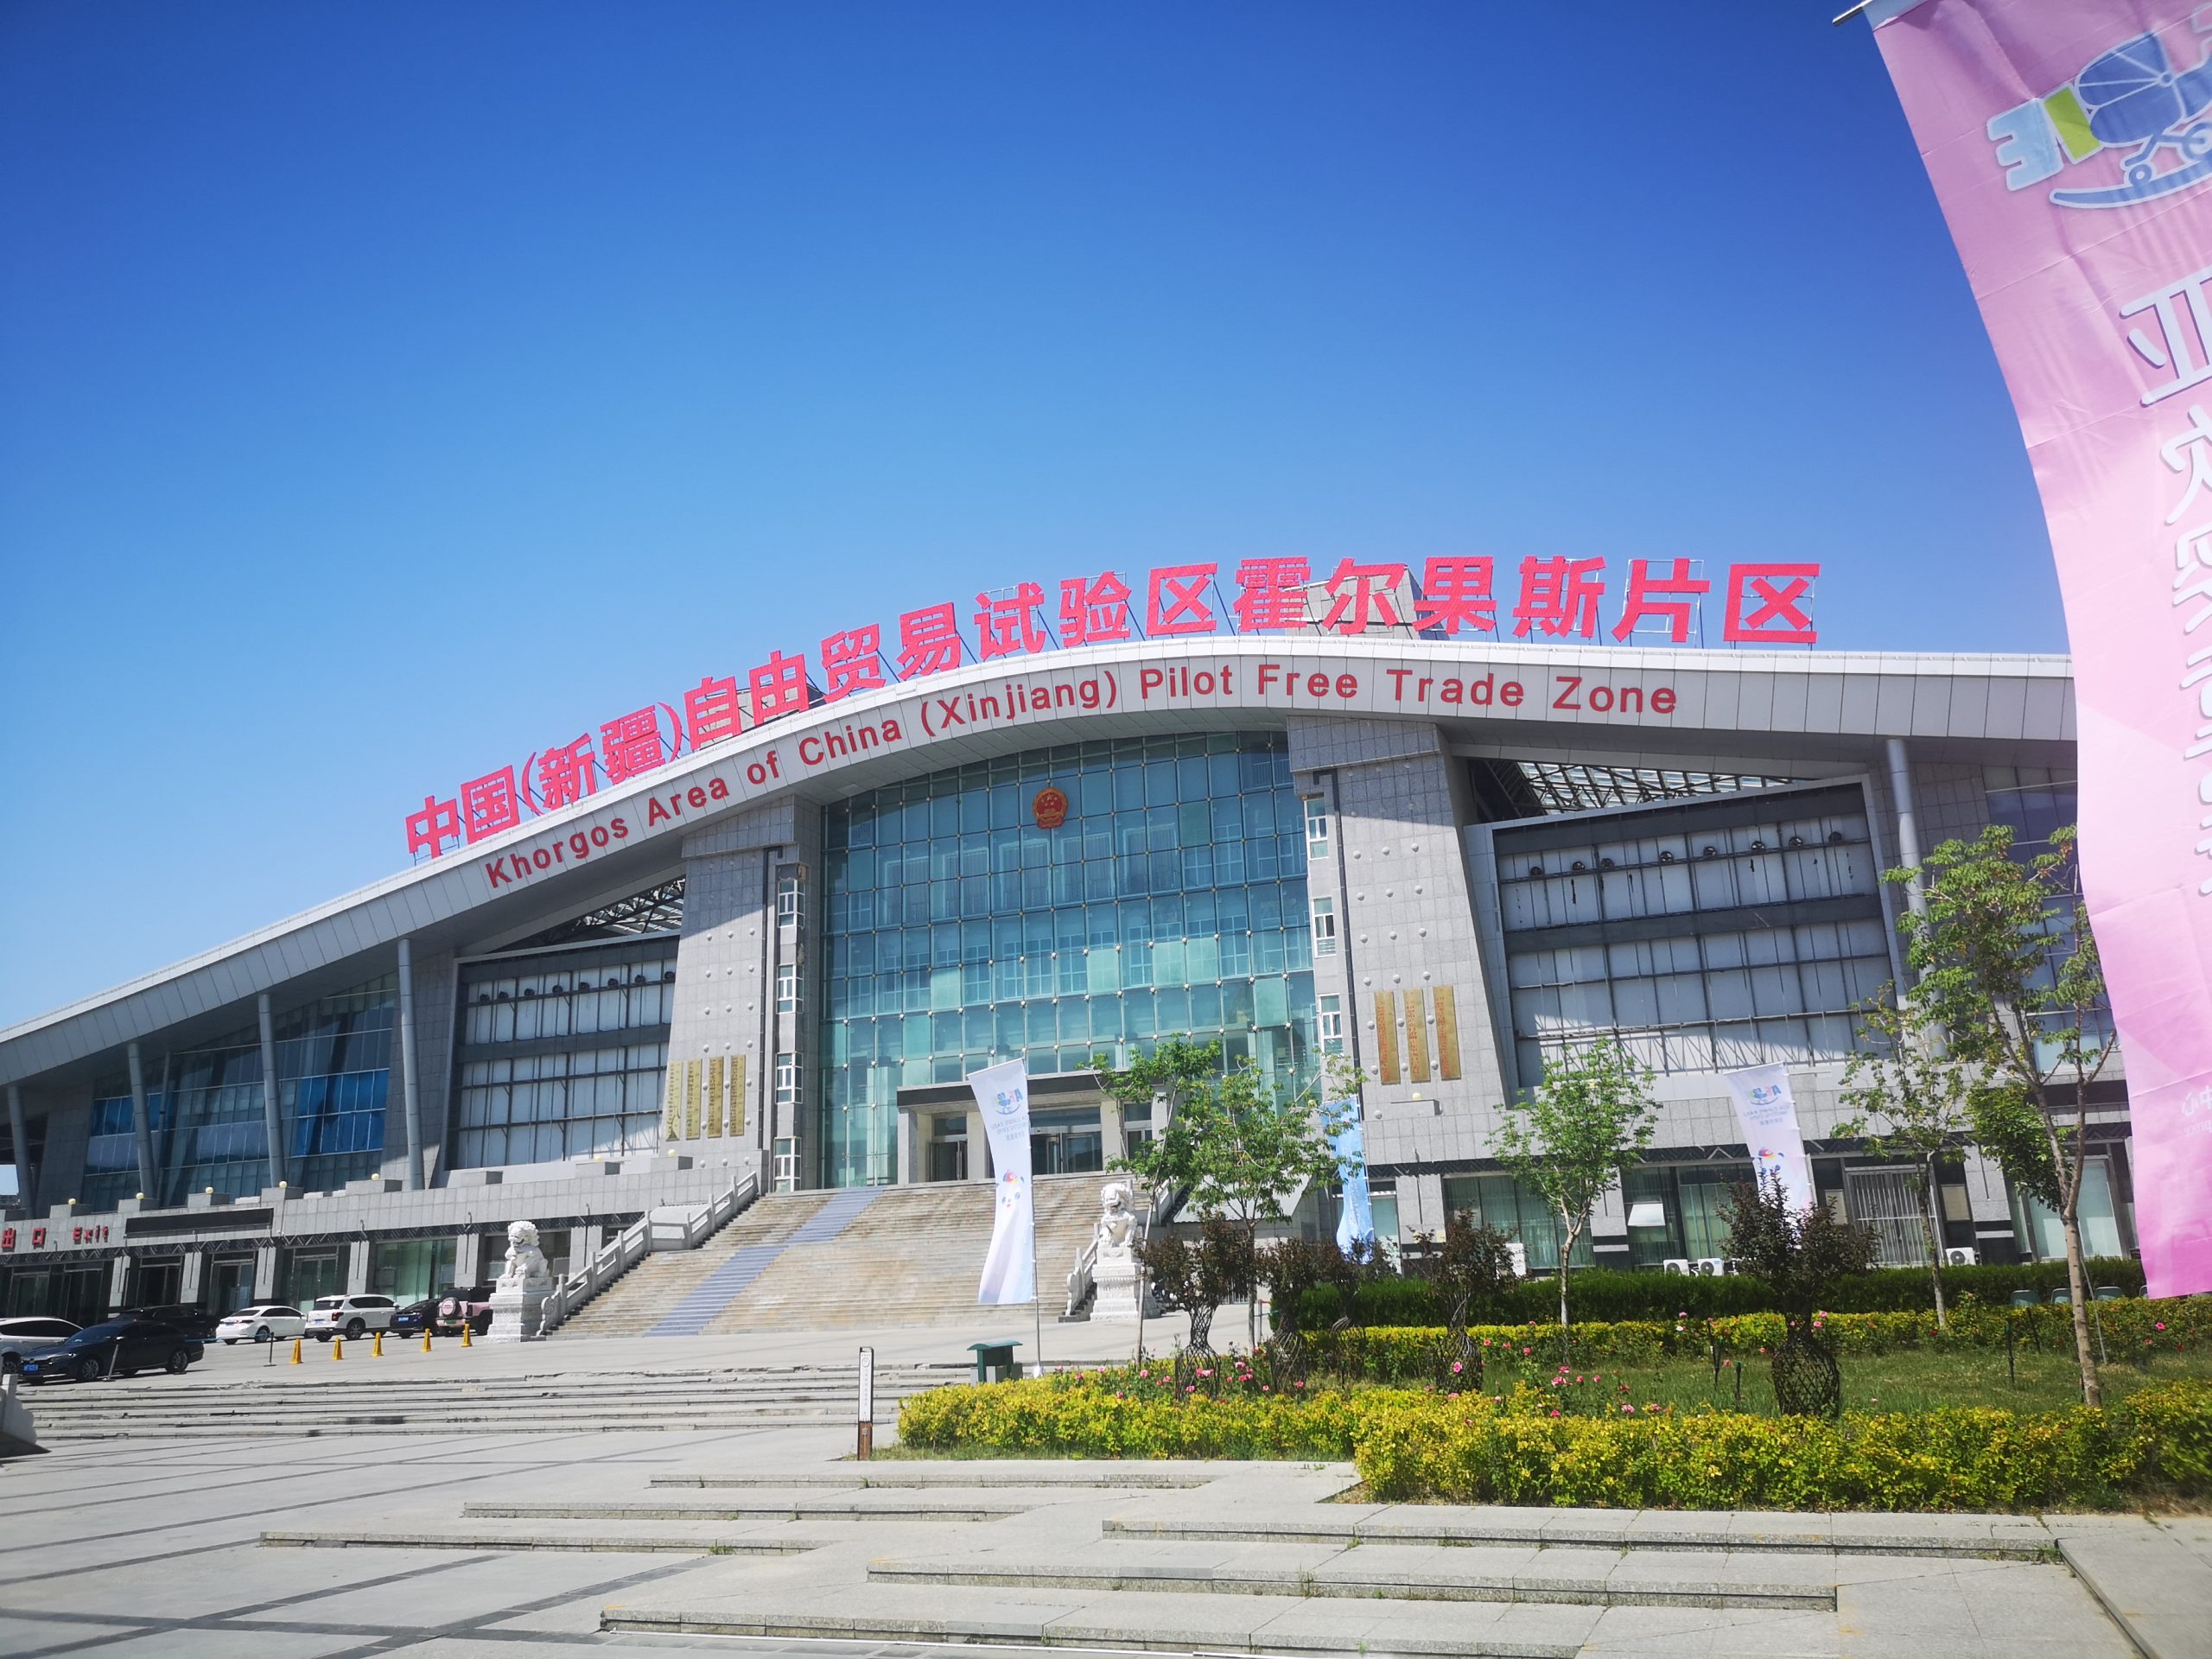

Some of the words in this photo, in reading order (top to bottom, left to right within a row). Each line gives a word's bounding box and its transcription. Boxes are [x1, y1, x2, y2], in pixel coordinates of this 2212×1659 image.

[486, 818, 629, 888] Khorgos
[648, 779, 730, 828] Area
[747, 749, 780, 785] of
[798, 718, 903, 766] China
[920, 671, 1118, 738] (Xinjiang)
[1139, 664, 1234, 701] Pilot
[1257, 664, 1359, 699] Free
[1386, 669, 1525, 708] Trade
[1552, 677, 1678, 715] Zone
[2, 1227, 47, 1249] 出口
[73, 1224, 109, 1243] Exit
